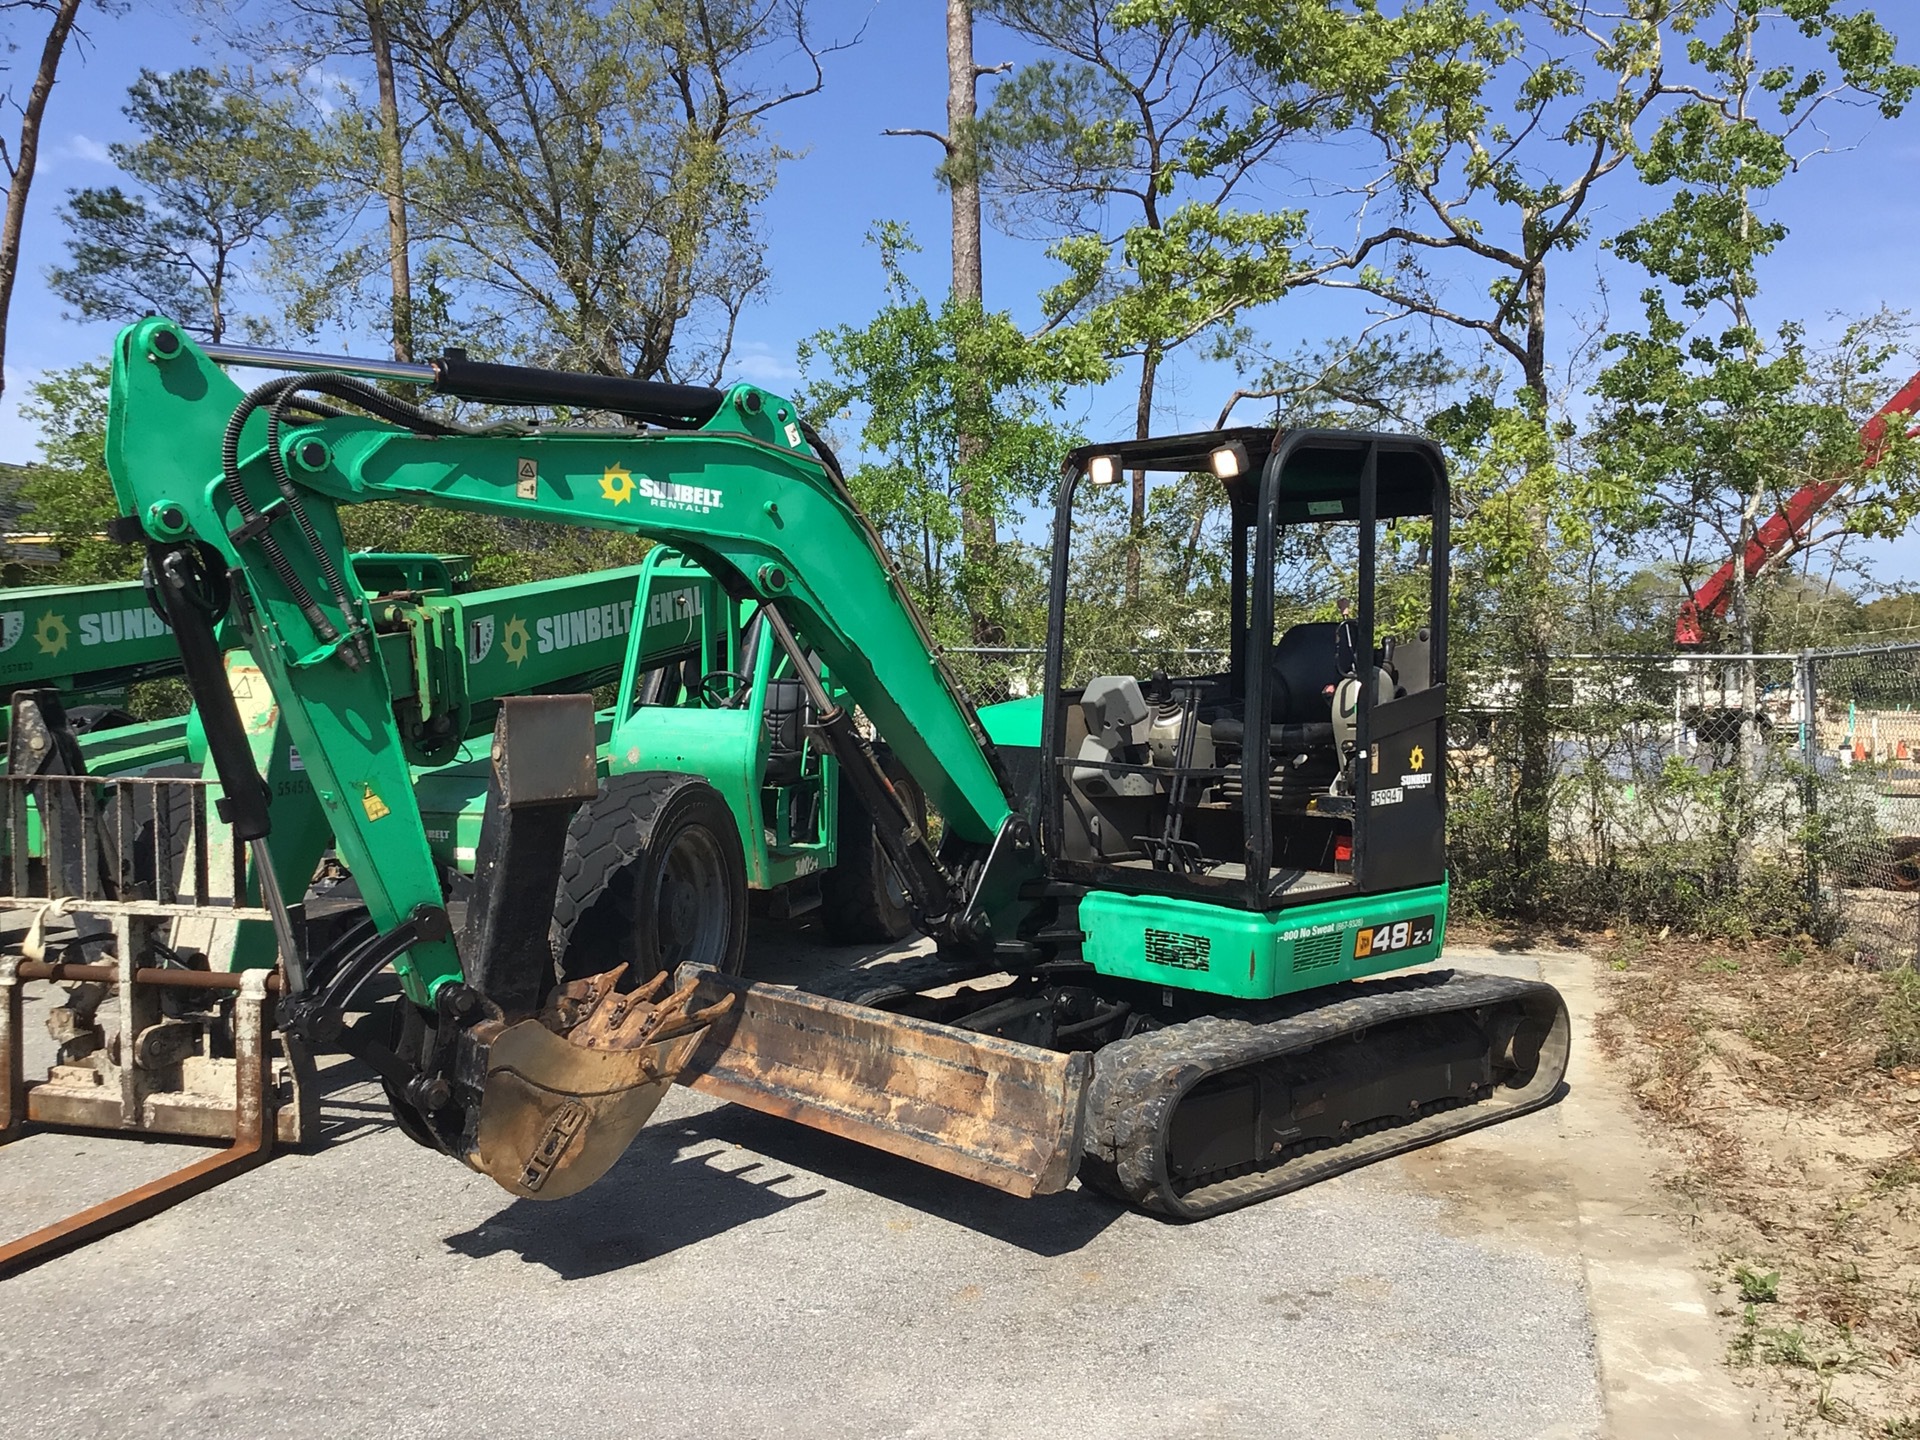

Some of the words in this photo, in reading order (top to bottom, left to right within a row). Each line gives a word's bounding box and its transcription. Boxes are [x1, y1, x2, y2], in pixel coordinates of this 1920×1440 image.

[639, 478, 723, 508] SUNBELT
[650, 498, 710, 514] RENTALS
[78, 606, 173, 646] SUNB
[536, 600, 633, 654] SUNBELT
[646, 586, 702, 628] ENTAL
[1401, 773, 1432, 786] SUNBELT
[1300, 927, 1311, 939] No
[1312, 923, 1335, 936] Sweat
[1373, 922, 1409, 952] 48
